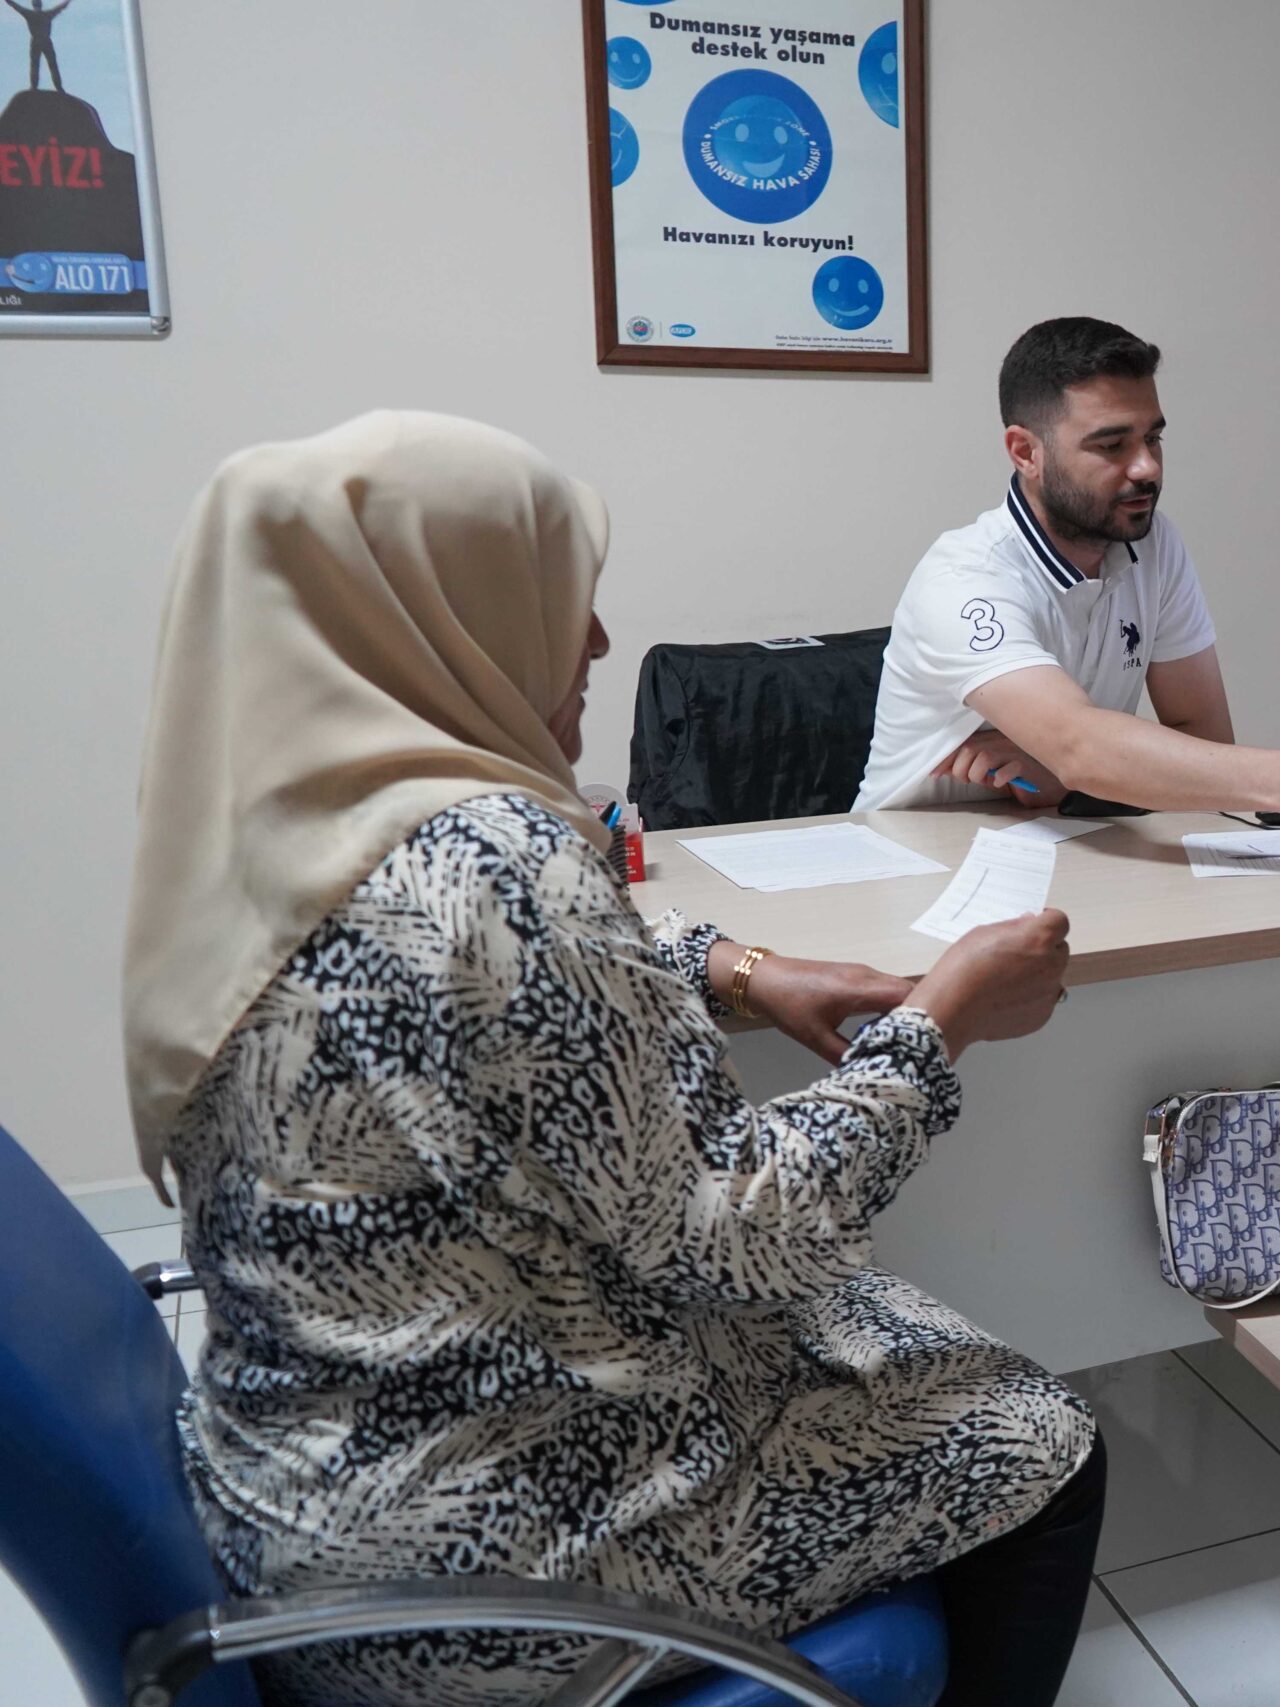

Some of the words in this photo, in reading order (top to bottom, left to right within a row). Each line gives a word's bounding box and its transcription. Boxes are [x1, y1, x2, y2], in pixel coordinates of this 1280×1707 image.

[650, 12, 761, 38] Dumansız
[769, 27, 856, 47] yaşama
[691, 36, 768, 60] destek
[777, 45, 825, 65] olun
[700, 141, 748, 187] DUMANSIZ
[752, 175, 800, 190] HAVA
[797, 148, 821, 180] SAHASI
[663, 226, 755, 246] Havanızı
[763, 231, 854, 252] koruyun!
[55, 264, 94, 290] ALO
[98, 264, 131, 291] 171
[961, 598, 1004, 651] 3
